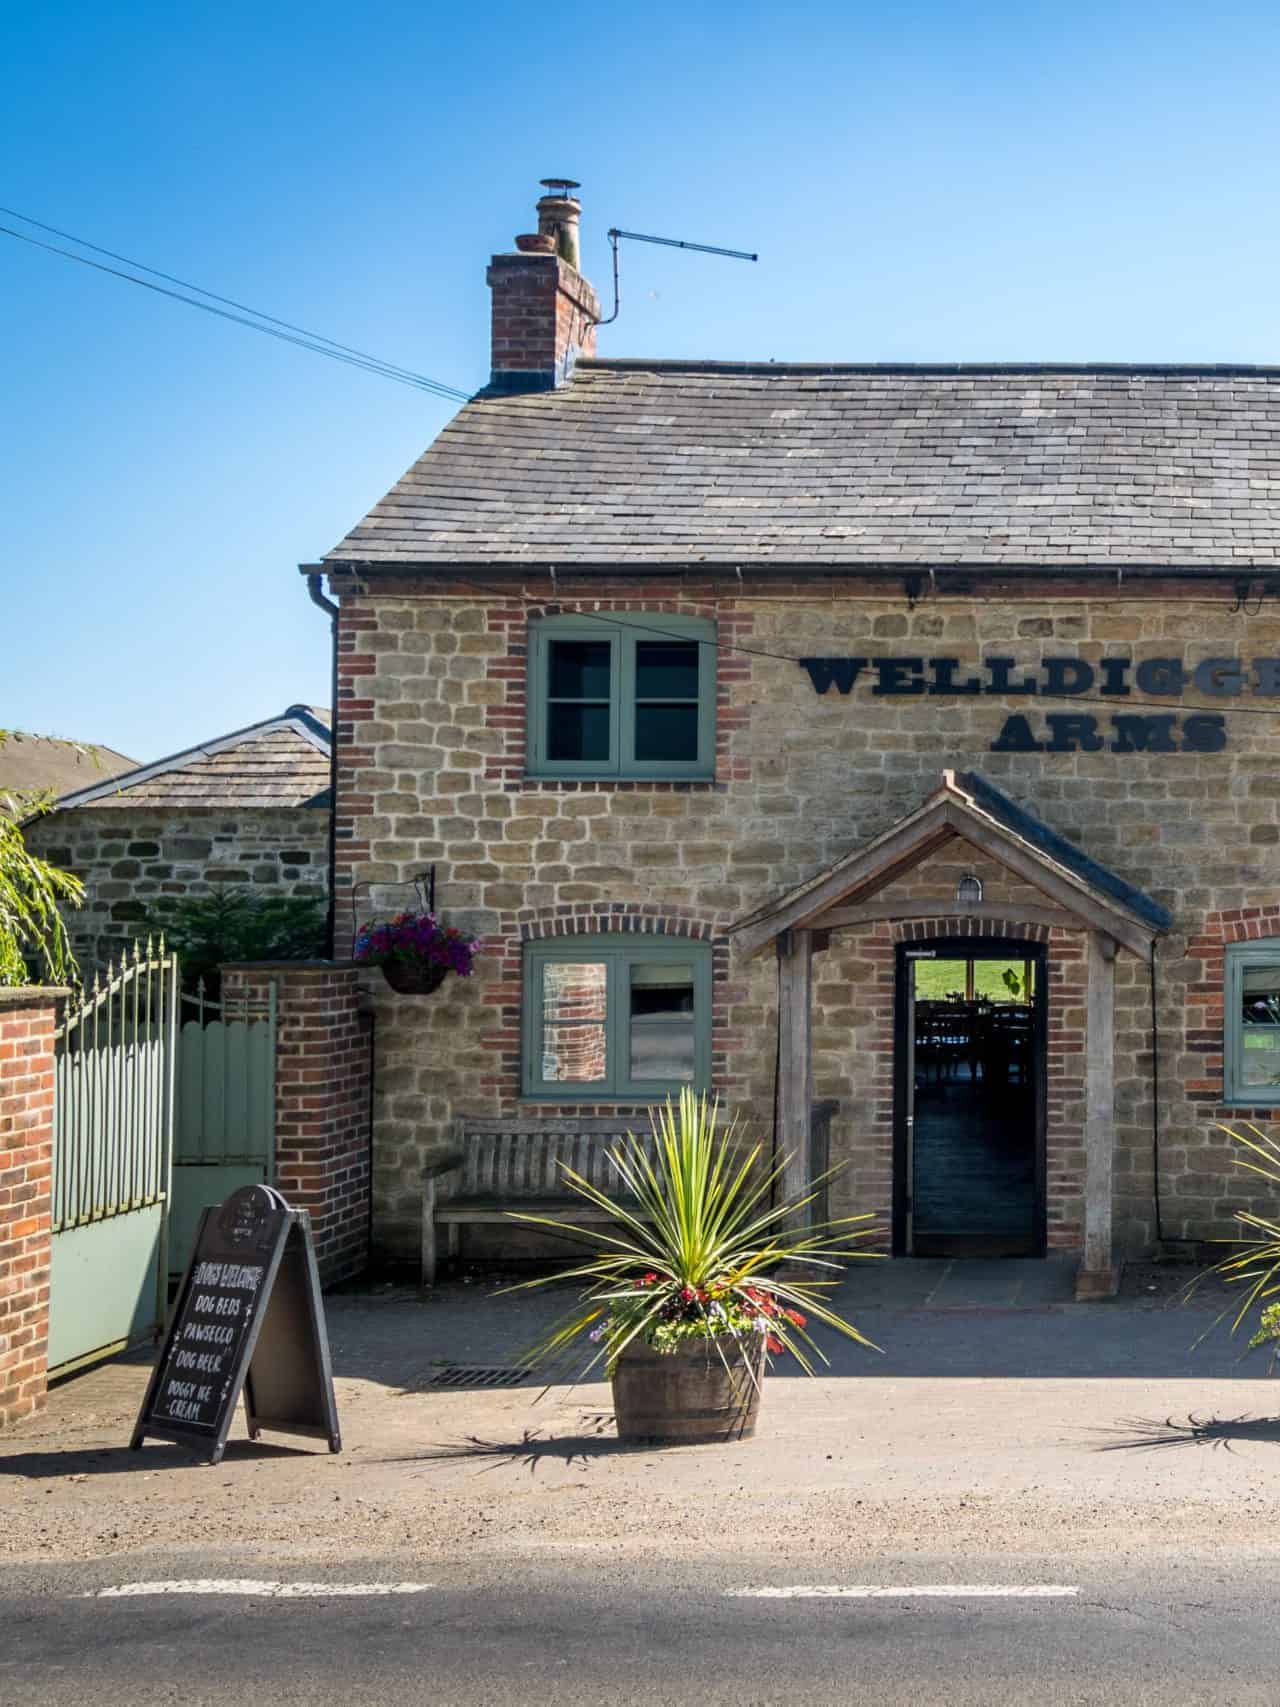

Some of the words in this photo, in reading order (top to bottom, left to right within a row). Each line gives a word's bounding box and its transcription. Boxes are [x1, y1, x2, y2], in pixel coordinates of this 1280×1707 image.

[990, 714, 1227, 753] ARMS
[195, 1262, 222, 1286] DOGS
[195, 1295, 214, 1313] DOG
[216, 1297, 241, 1316] BEDS
[183, 1322, 234, 1345] PAWSECCO
[176, 1350, 197, 1369] DOG
[197, 1353, 223, 1373] BEER
[168, 1380, 196, 1398] DOGGY
[197, 1385, 213, 1402] ICE
